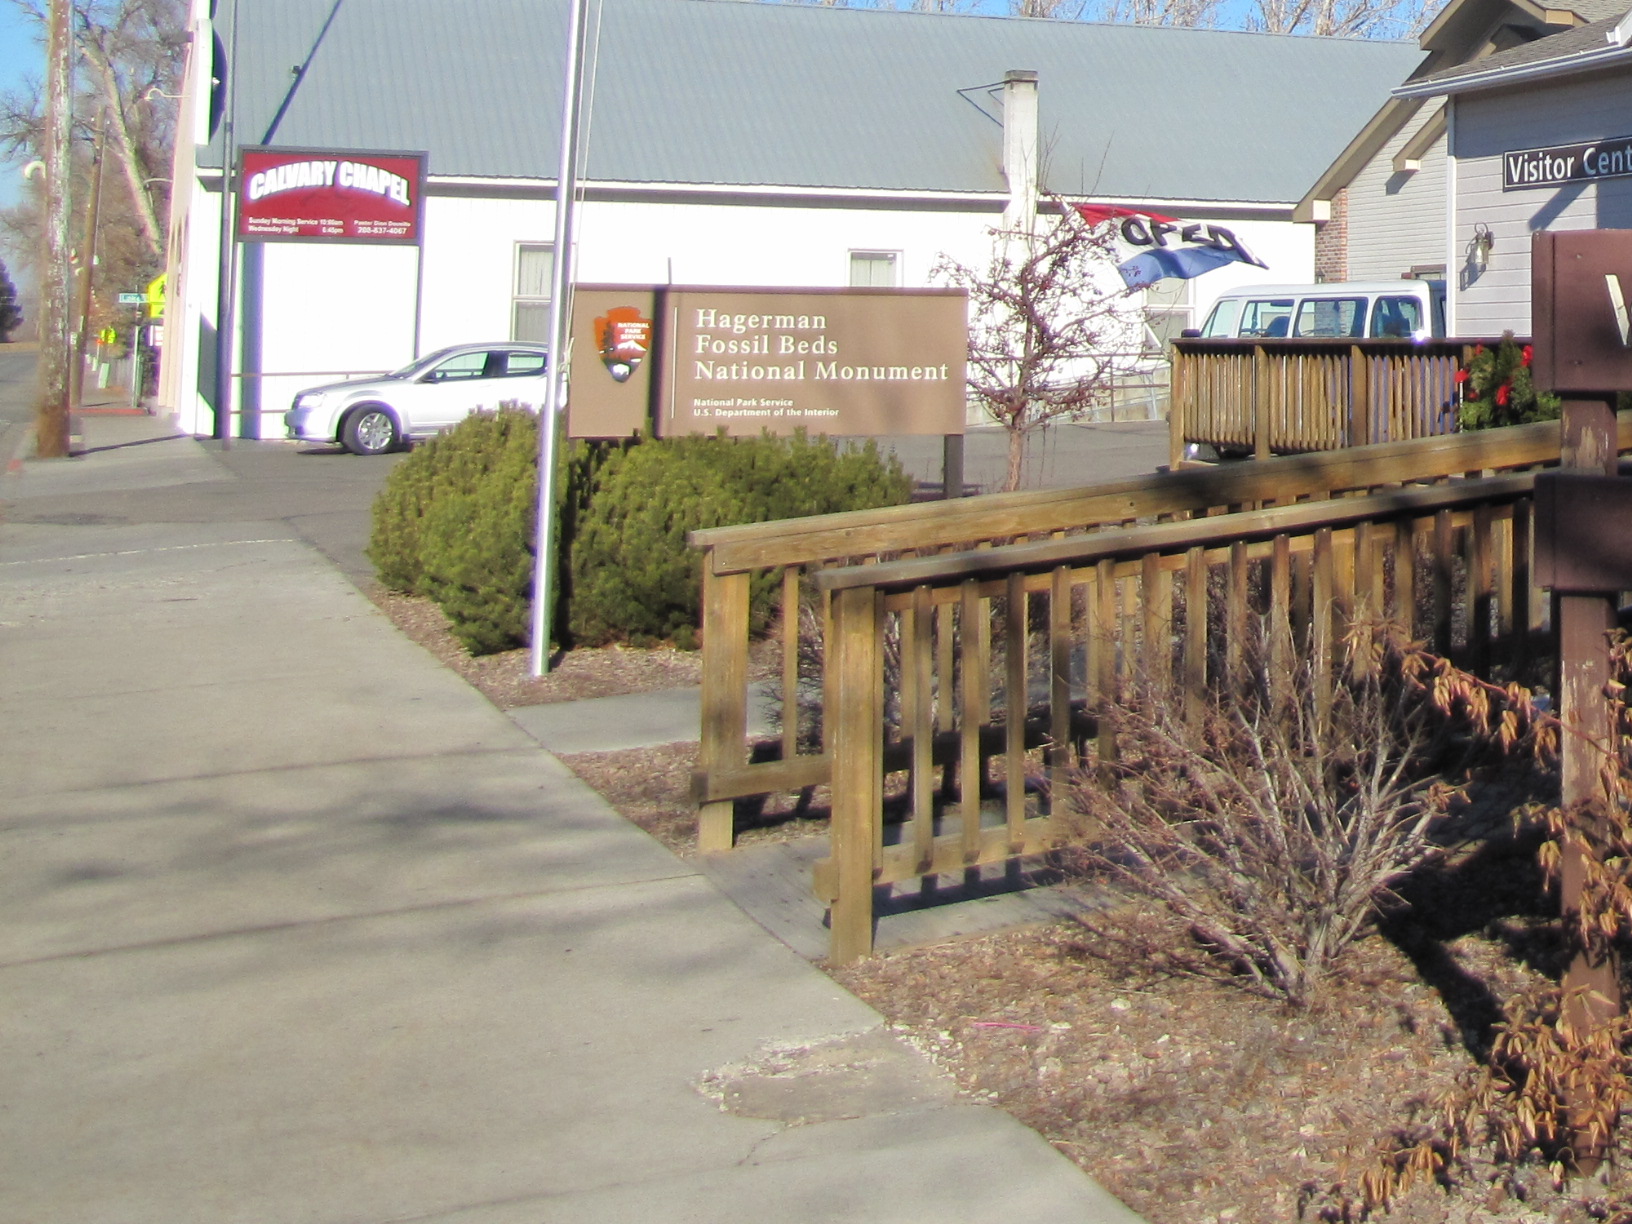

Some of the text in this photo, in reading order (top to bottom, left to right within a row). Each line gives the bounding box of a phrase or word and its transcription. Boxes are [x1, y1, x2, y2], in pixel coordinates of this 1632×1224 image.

[1509, 152, 1575, 182] Visitor
[249, 161, 411, 206] CALVARY CHAPEL
[248, 217, 271, 226] Sunday
[271, 217, 296, 226] Morning
[297, 218, 319, 226] Service
[248, 225, 282, 234] Wednesday
[282, 226, 299, 234] Night
[1121, 216, 1270, 271] OPEN
[695, 308, 827, 334] Hagerman
[695, 334, 840, 354] Fossil Beds
[694, 360, 950, 381] National Monument
[693, 398, 794, 407] National Park Service
[693, 408, 839, 418] U.S. Department of the Interior
